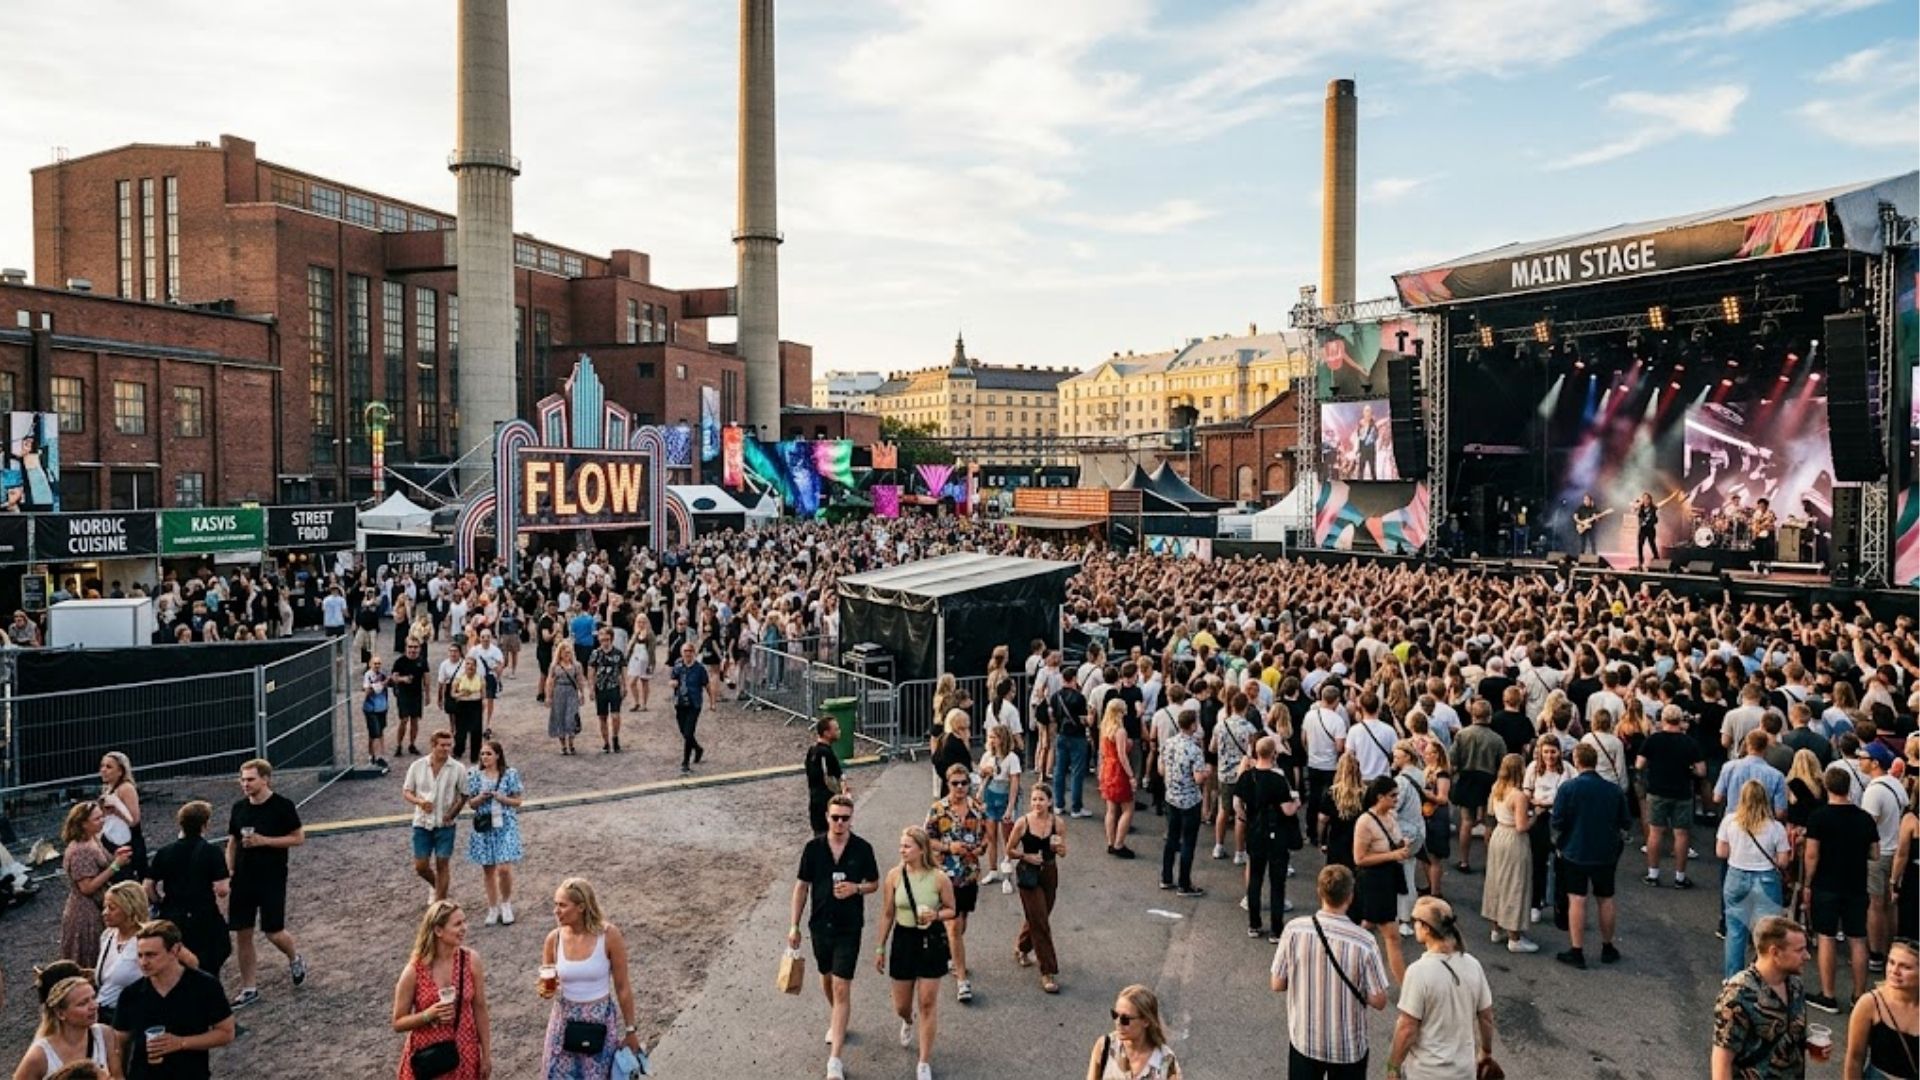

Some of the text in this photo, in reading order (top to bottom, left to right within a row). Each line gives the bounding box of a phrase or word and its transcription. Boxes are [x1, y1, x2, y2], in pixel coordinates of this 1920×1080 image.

[1511, 239, 1656, 288] MAIN STAGE
[525, 461, 643, 515] FLOW
[69, 518, 126, 535] NORDIC
[191, 515, 237, 532] KASVIS
[291, 510, 334, 526] STREET
[297, 526, 328, 541] FOOD
[68, 535, 128, 553] CUISINE
